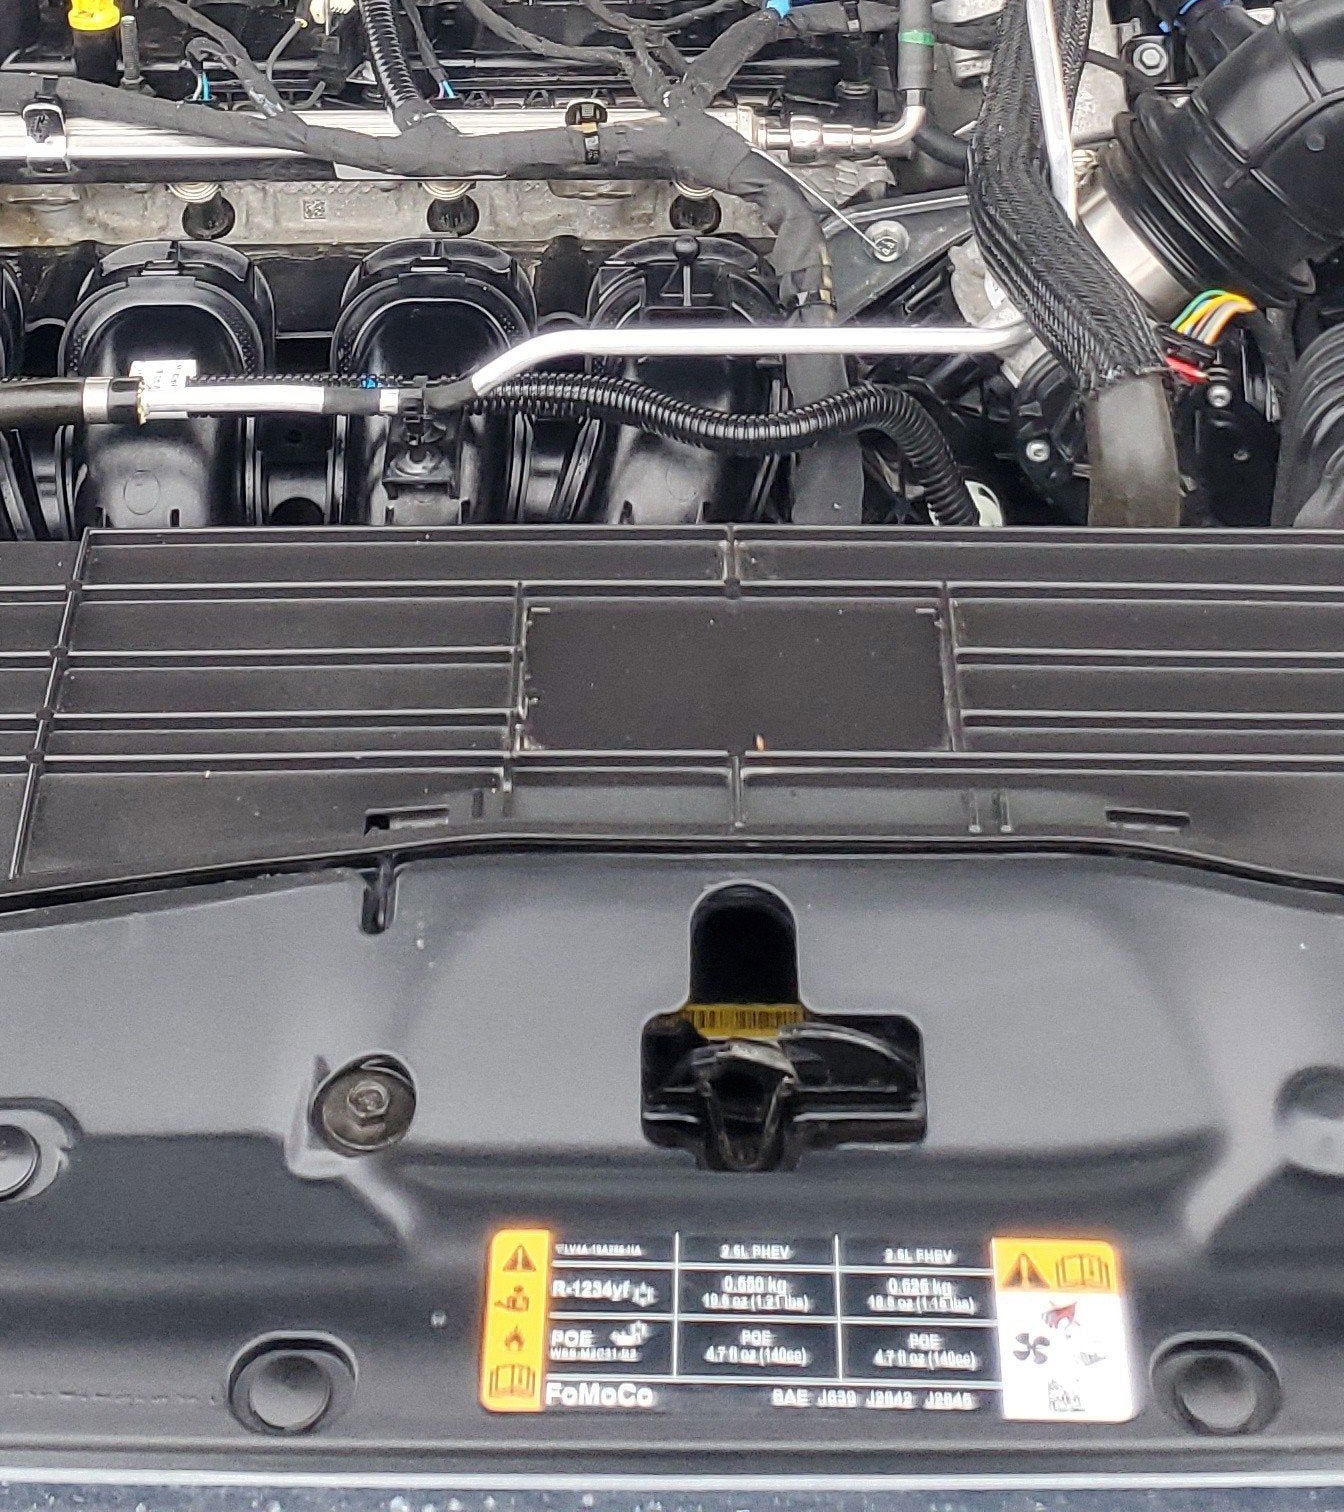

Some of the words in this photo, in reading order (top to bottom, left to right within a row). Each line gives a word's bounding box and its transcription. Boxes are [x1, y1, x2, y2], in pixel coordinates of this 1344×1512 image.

[552, 1279, 631, 1302] R-1234yf
[768, 1275, 787, 1296] kg
[932, 1278, 953, 1299] kg
[732, 1295, 749, 1309] oz
[897, 1298, 914, 1311] oz
[551, 1329, 594, 1346] POE
[740, 1329, 773, 1346] POE
[908, 1333, 941, 1349] POE
[545, 1382, 653, 1406] FoMoCo
[771, 1389, 810, 1406] SAE
